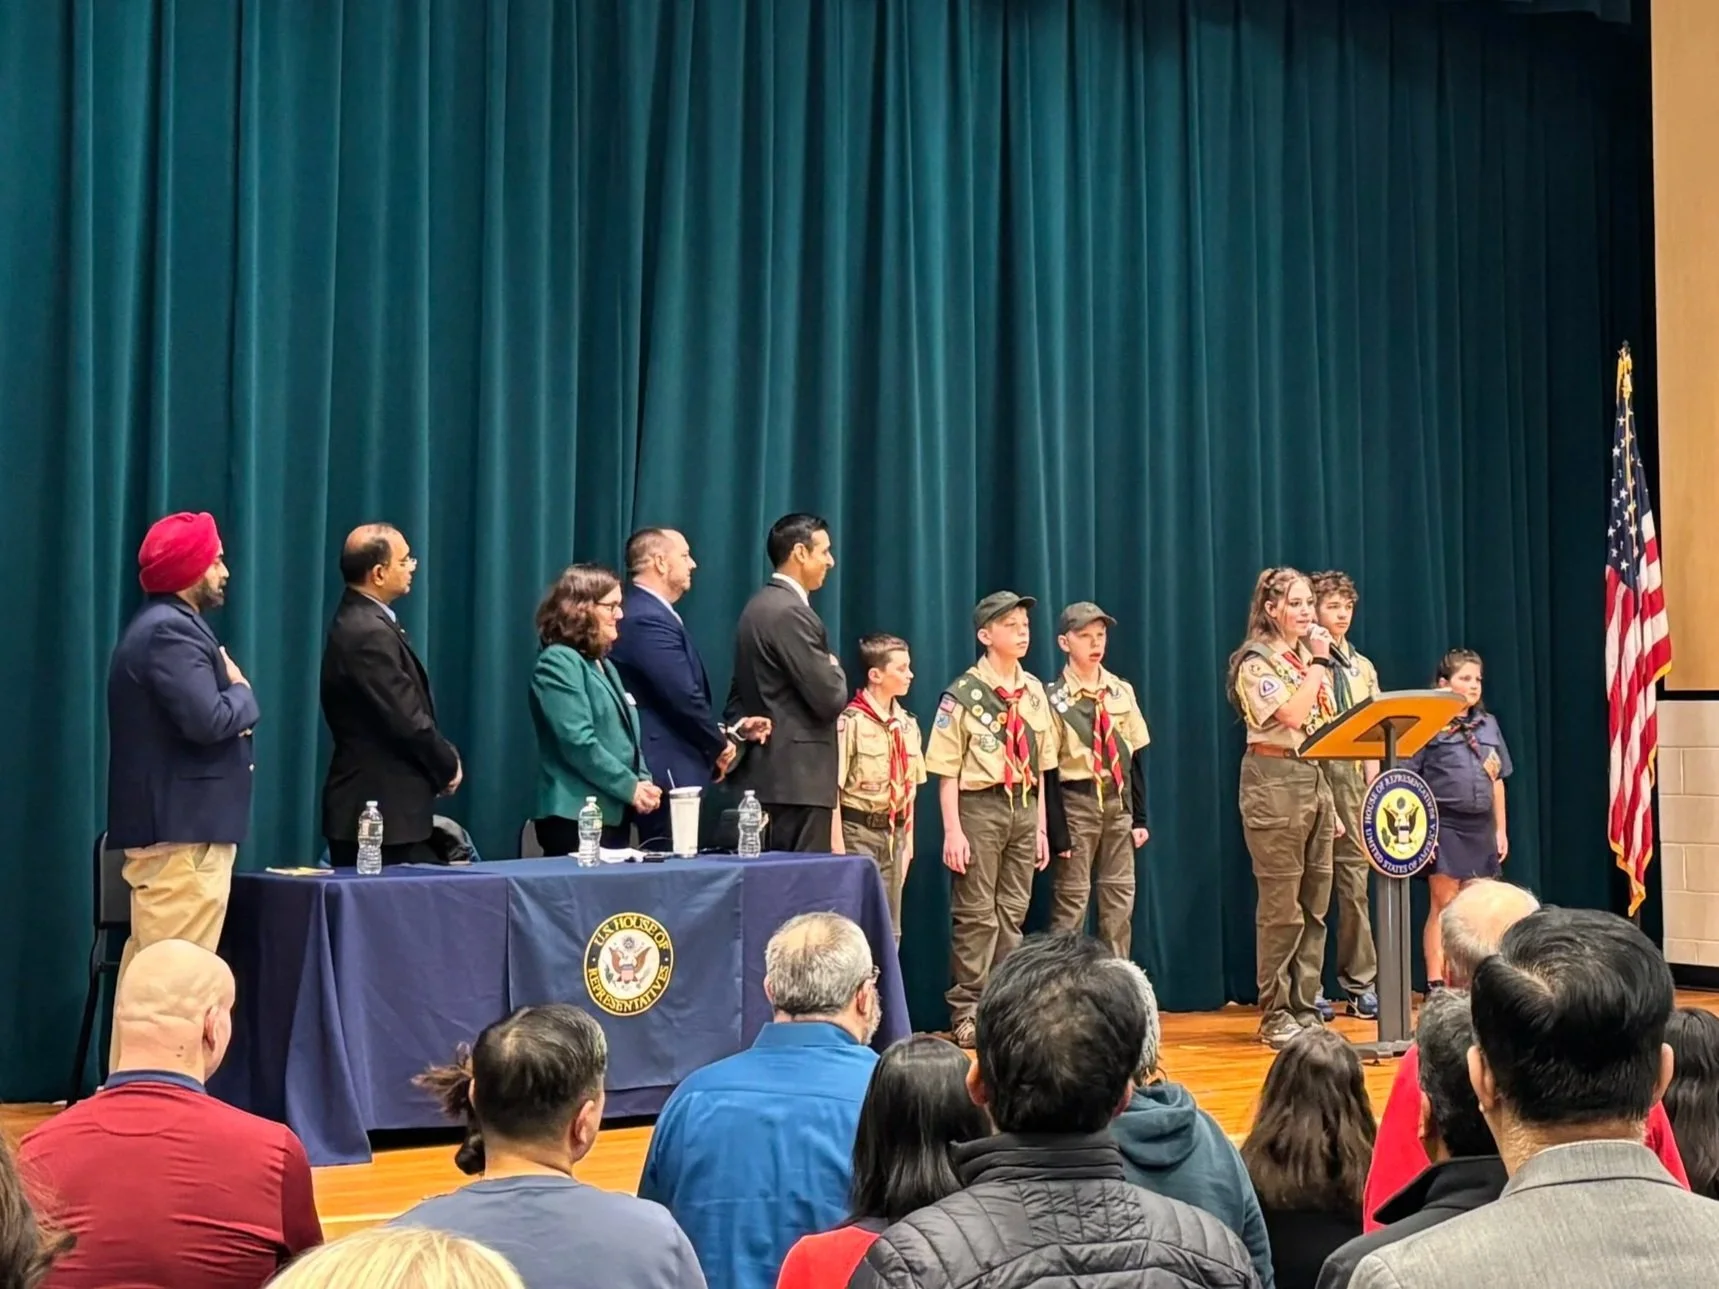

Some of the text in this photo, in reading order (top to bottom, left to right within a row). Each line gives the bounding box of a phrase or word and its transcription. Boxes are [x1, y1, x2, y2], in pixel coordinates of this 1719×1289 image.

[1364, 774, 1436, 824] HOUSE OF REPRESENTATIVES
[1365, 823, 1436, 873] UNITED STATES OF AMERICA
[613, 916, 658, 936] HOUSE
[654, 931, 669, 949] OF
[588, 965, 669, 1012] REPRESENTATIVES
